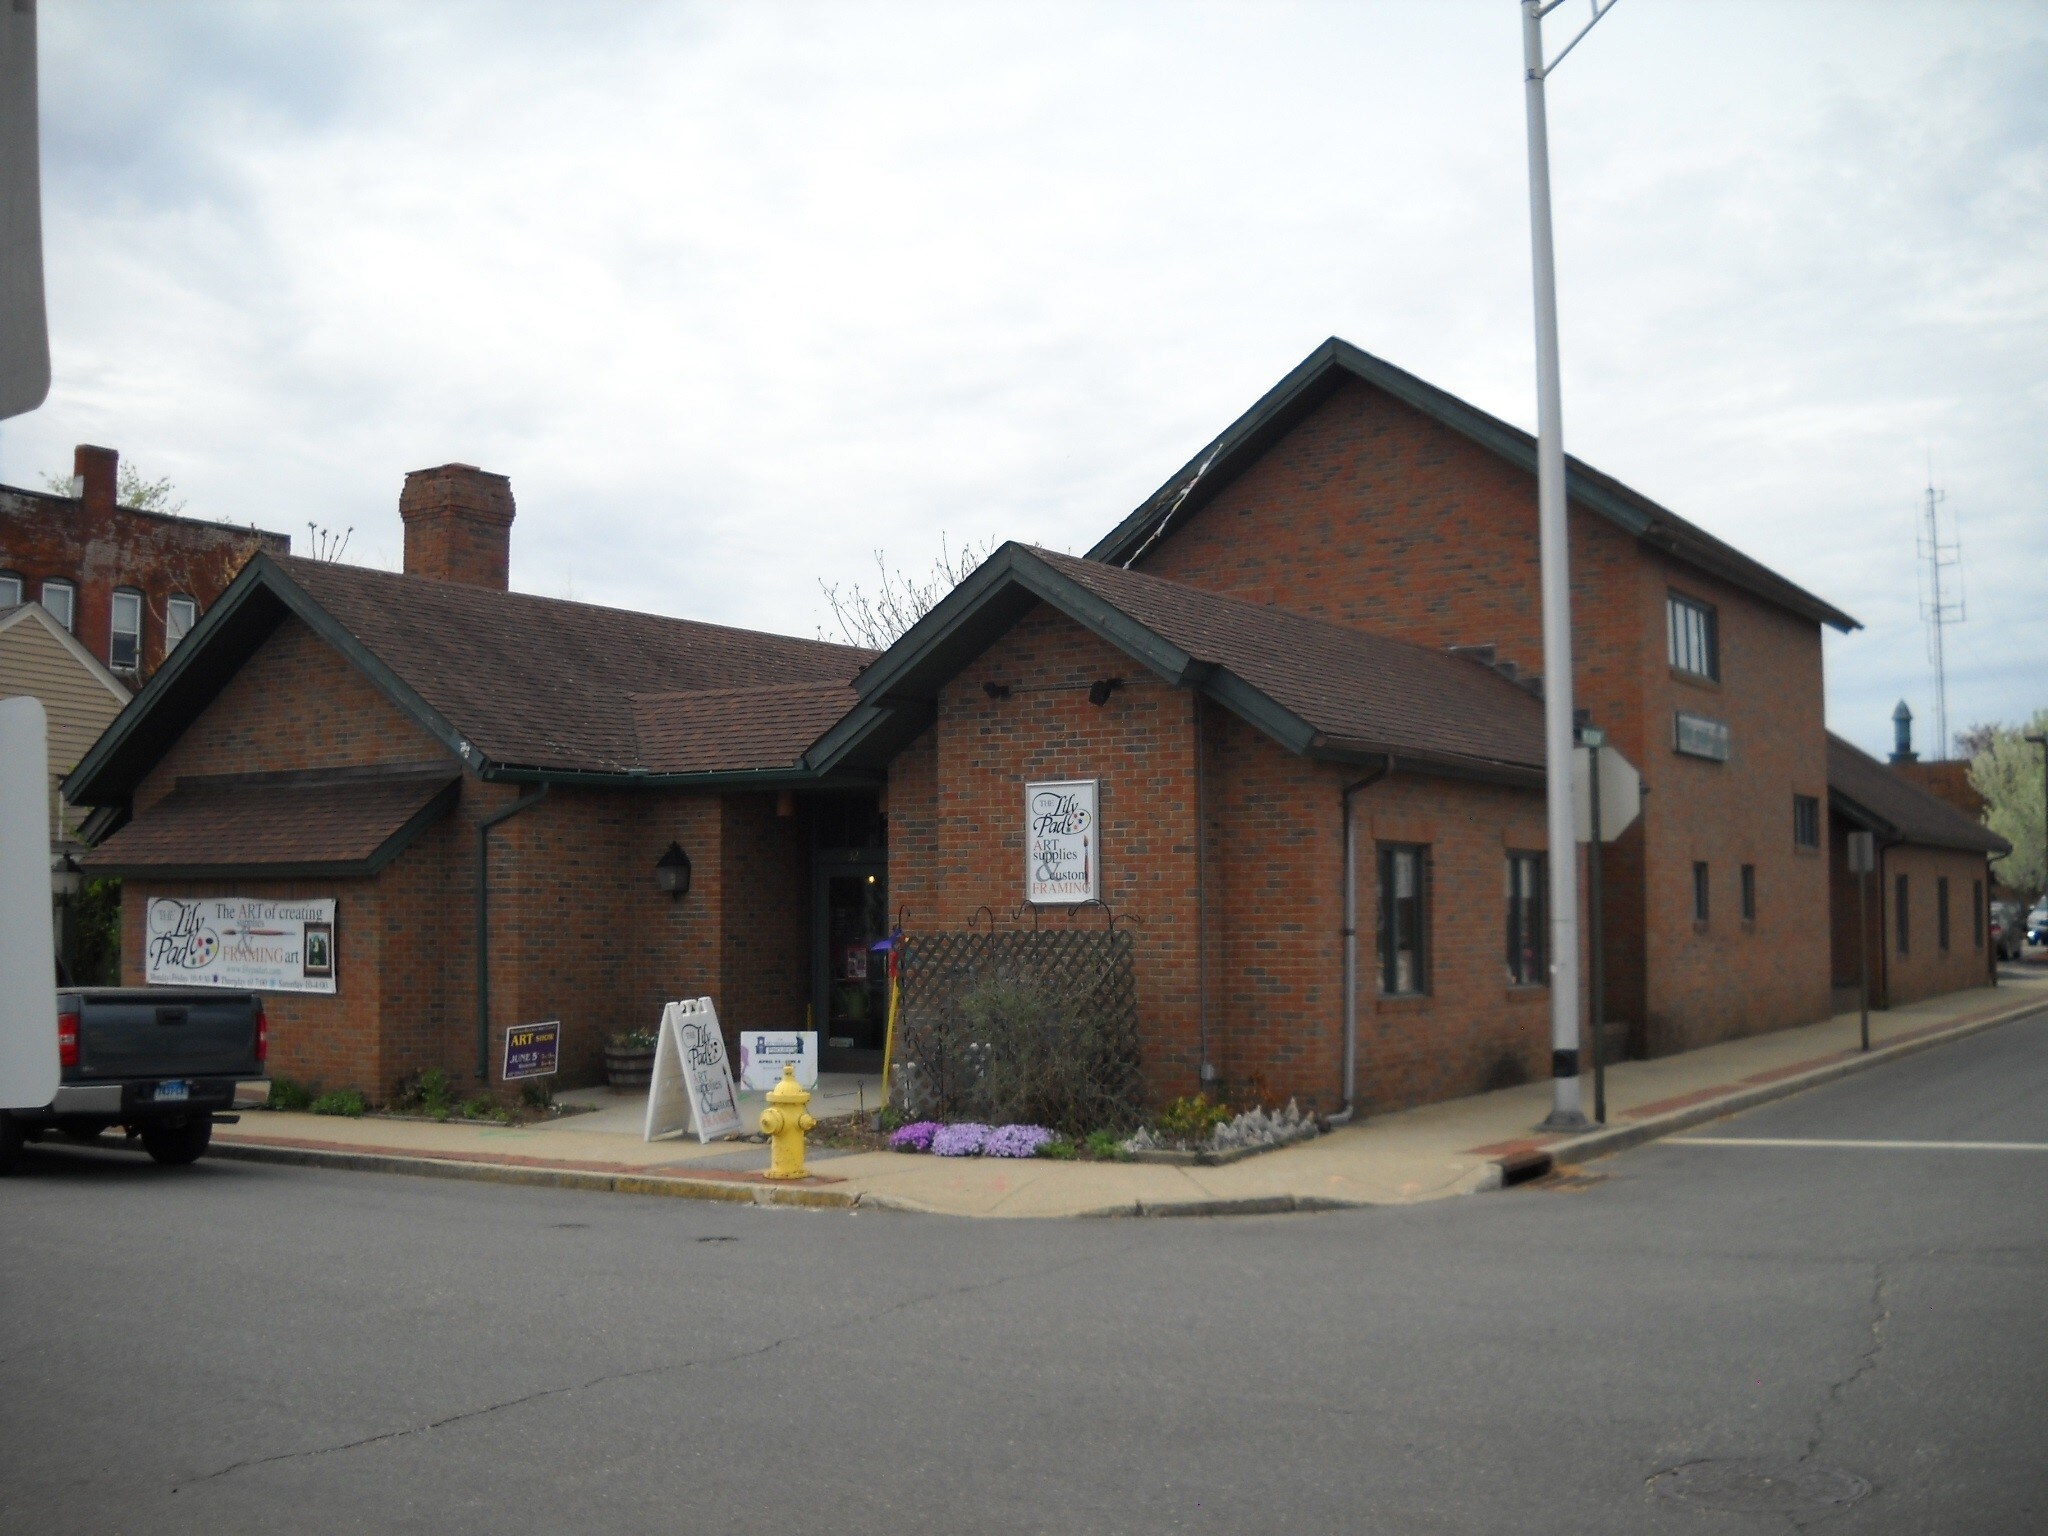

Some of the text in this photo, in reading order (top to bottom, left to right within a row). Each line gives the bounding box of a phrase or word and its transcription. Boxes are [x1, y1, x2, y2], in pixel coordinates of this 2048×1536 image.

[1034, 839, 1059, 851] ART
[1033, 848, 1078, 864] supplies
[1032, 882, 1091, 894] FRAMING
[159, 910, 175, 921] THE
[216, 903, 322, 922] The ART of creating
[223, 946, 299, 963] FRAMING art
[510, 1033, 533, 1046] ART
